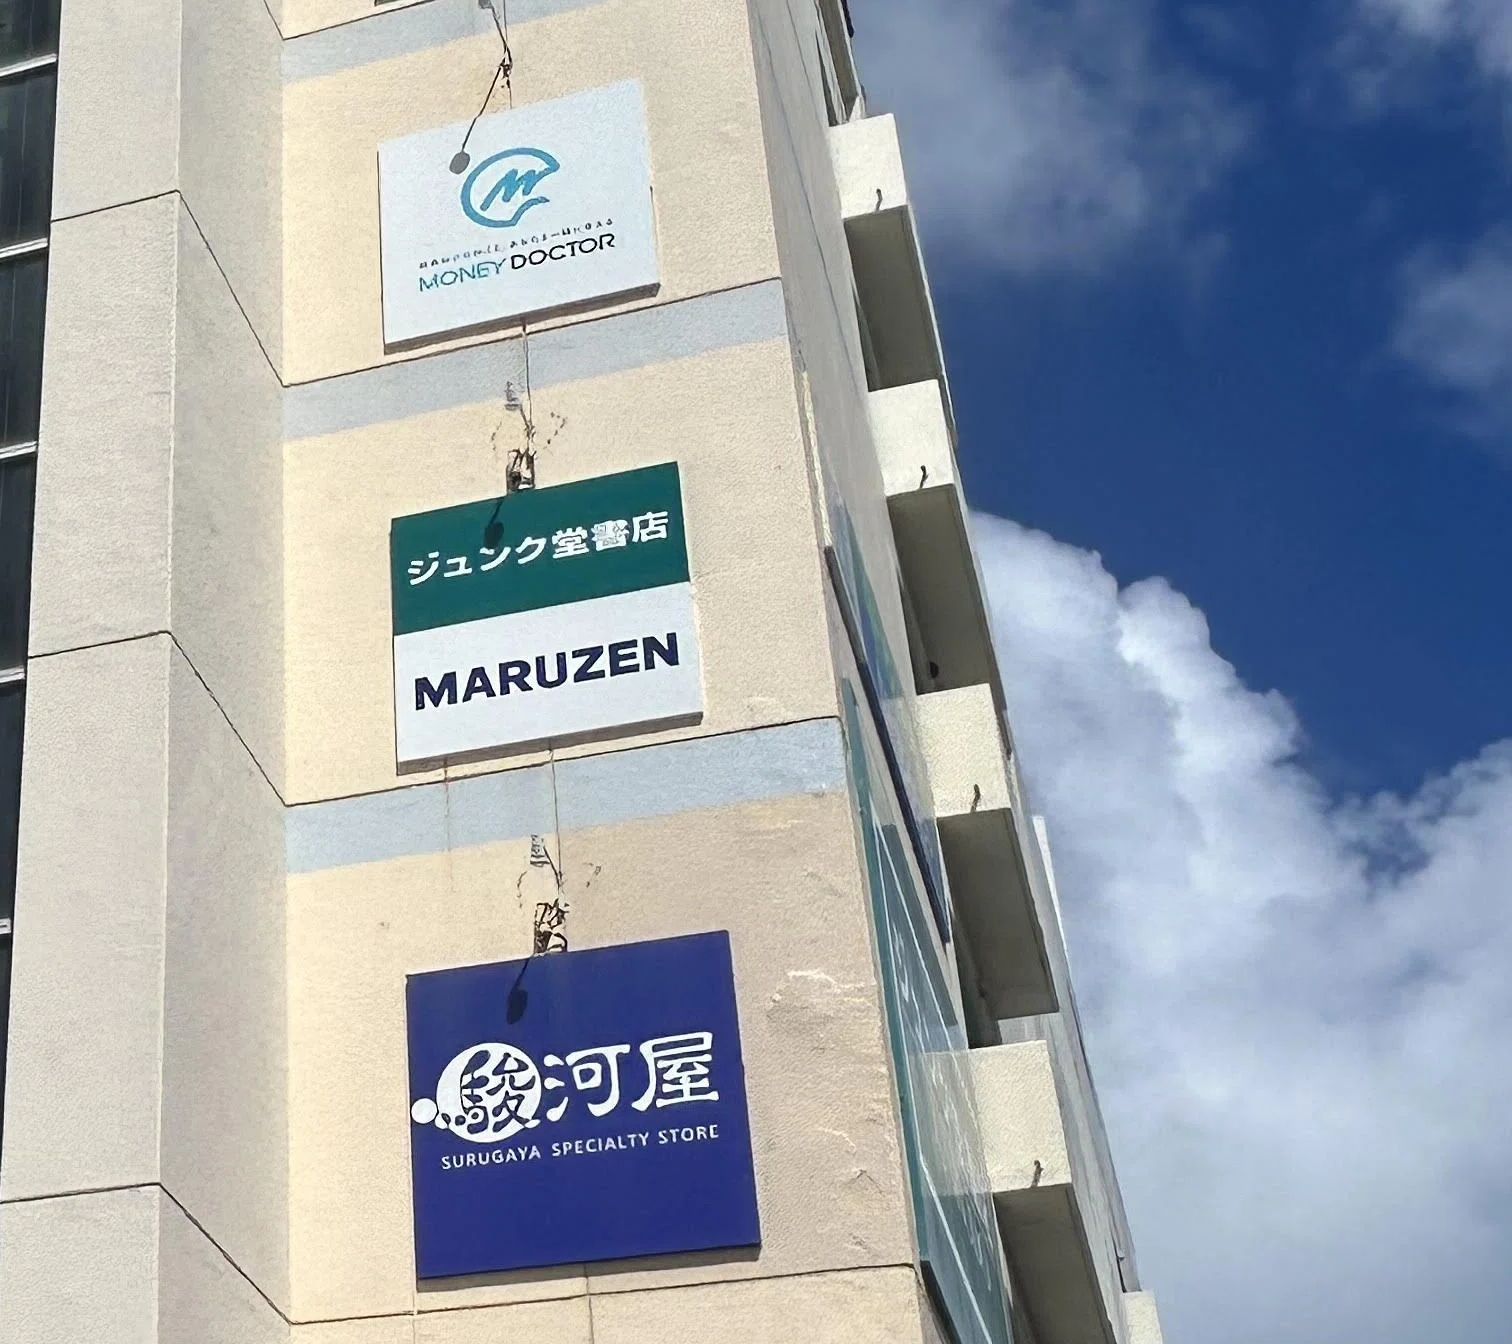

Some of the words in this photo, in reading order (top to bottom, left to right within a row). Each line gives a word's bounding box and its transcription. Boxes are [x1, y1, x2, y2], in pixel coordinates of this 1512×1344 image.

[419, 258, 507, 292] MONEY
[510, 233, 615, 270] DOCTOR
[406, 510, 670, 586] ジュンク堂書店
[414, 631, 680, 711] MARUZEN
[438, 1031, 720, 1142] 駿河屋
[441, 1145, 541, 1171] SURUGAYA
[551, 1131, 650, 1157] SPECIALTY
[657, 1123, 720, 1146] STORE
